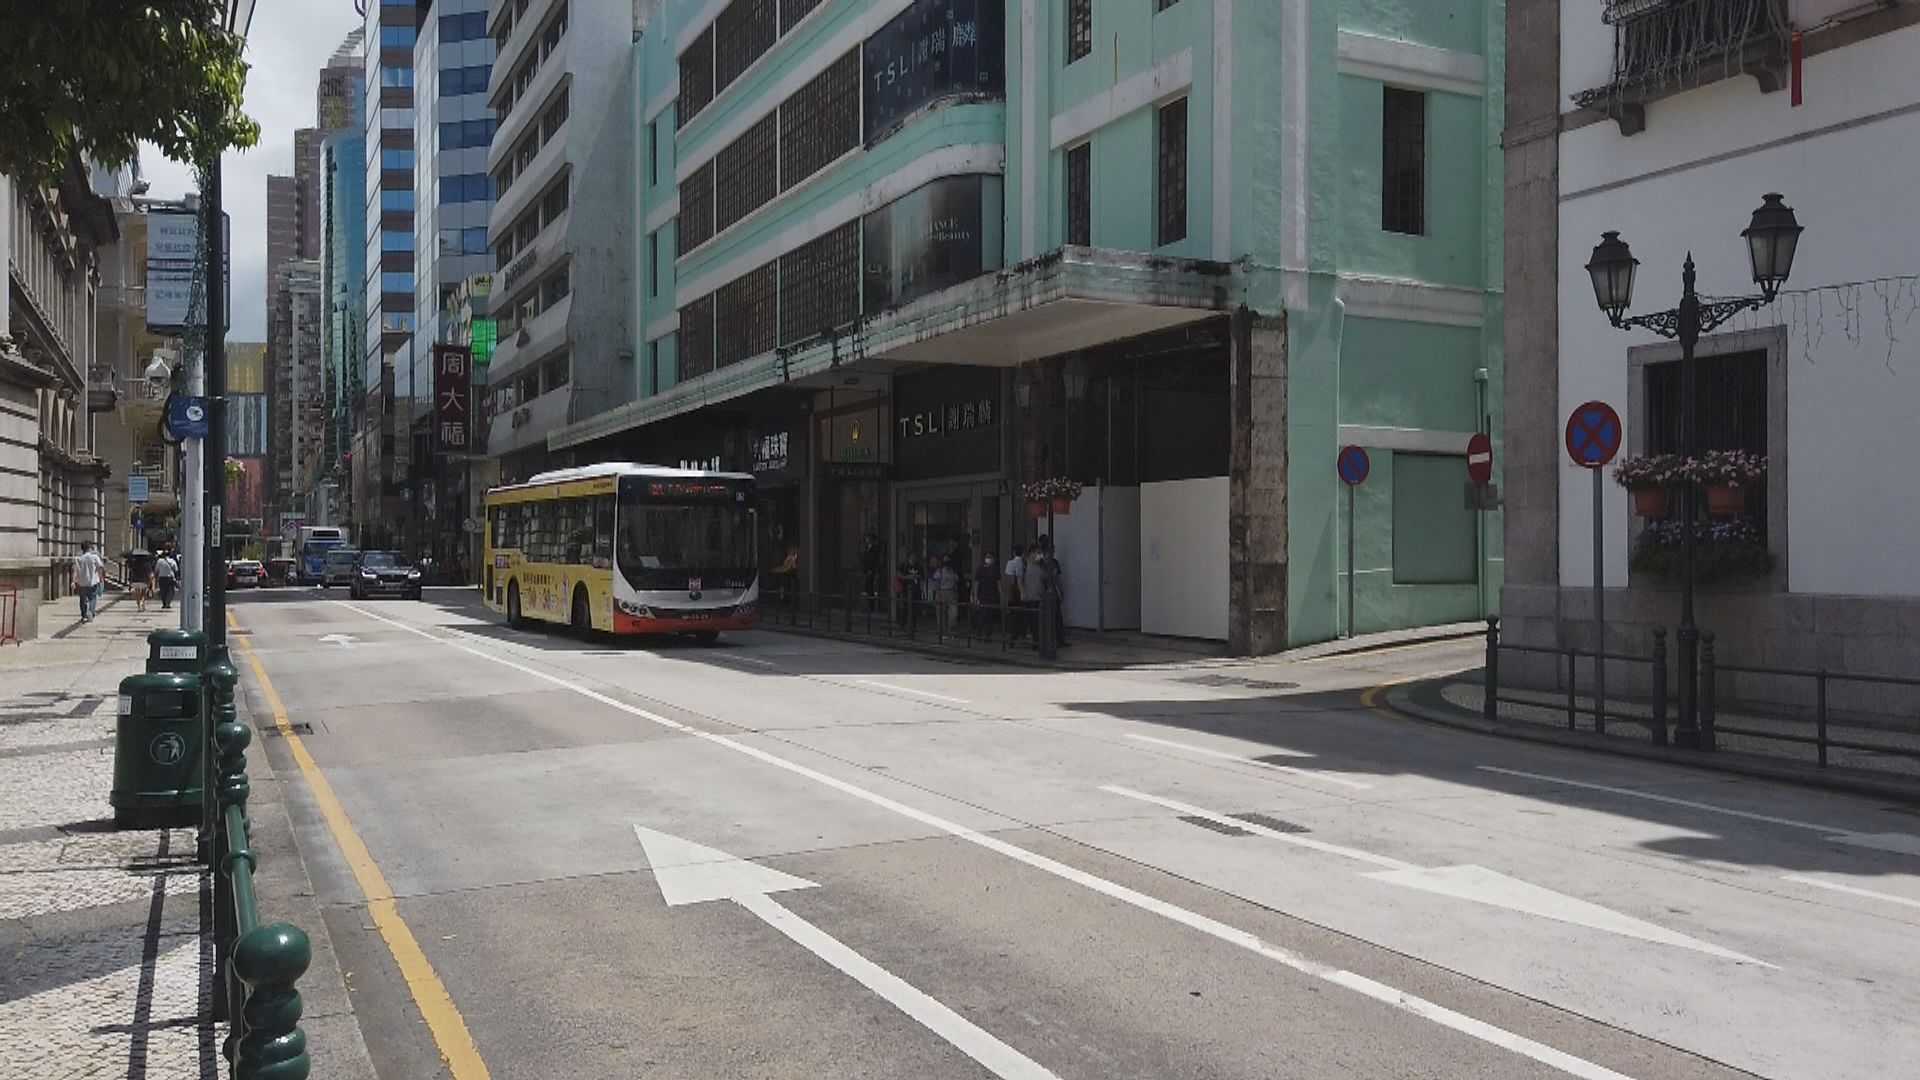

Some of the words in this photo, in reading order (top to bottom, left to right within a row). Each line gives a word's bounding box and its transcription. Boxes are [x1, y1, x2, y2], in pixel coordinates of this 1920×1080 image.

[874, 56, 908, 93] TSL
[441, 352, 464, 445] 周大福
[900, 411, 938, 437] TSL
